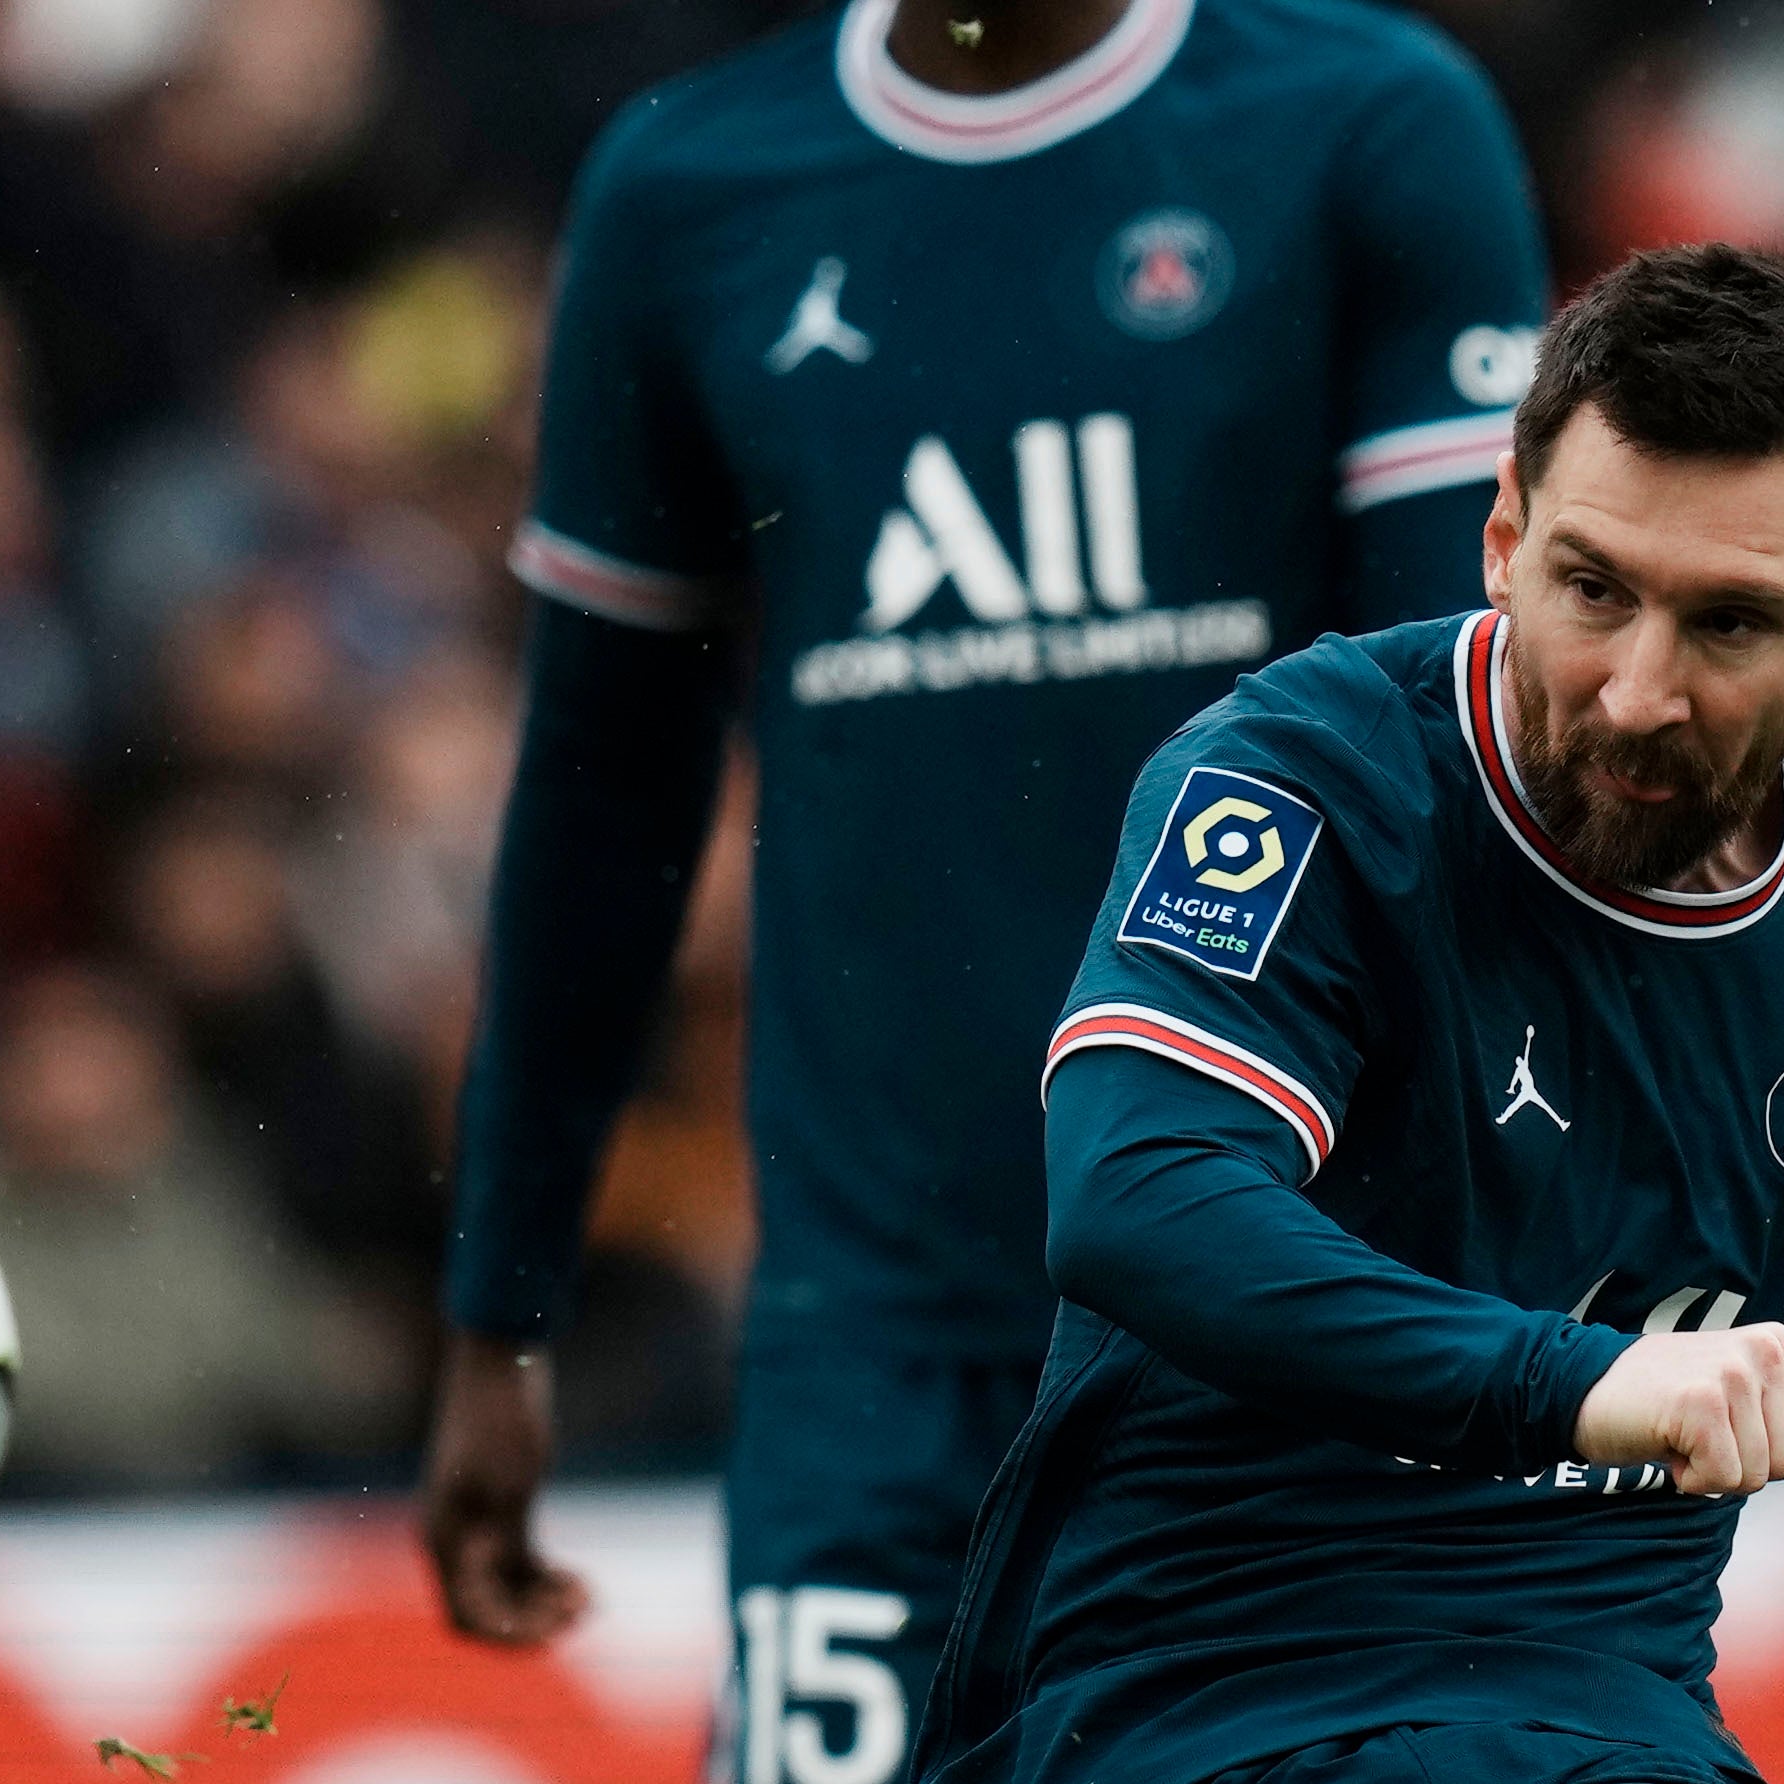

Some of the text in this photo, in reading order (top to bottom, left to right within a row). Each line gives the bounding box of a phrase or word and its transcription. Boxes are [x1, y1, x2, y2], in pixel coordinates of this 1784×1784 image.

[1142, 906, 1250, 954] Uber Eats
[1159, 892, 1255, 928] LIGUE 1
